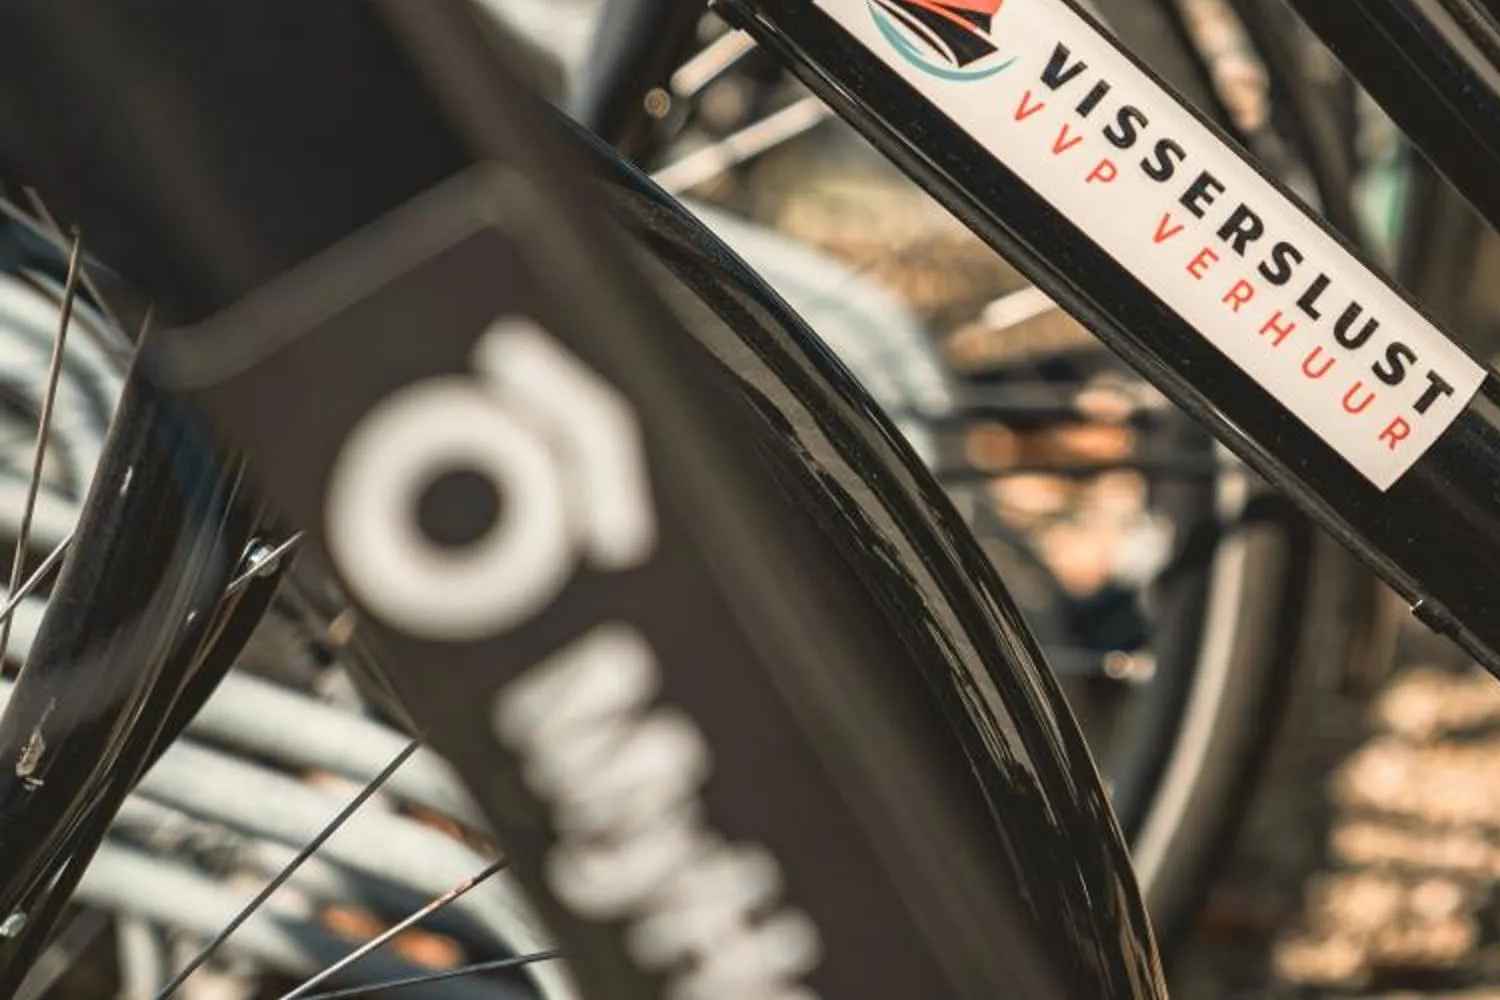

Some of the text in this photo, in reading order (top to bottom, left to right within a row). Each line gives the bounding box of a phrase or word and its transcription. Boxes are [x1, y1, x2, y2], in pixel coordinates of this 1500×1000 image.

[1012, 90, 1411, 451] VVP VERHUUR
[1040, 42, 1455, 415] VISSERSLUST
